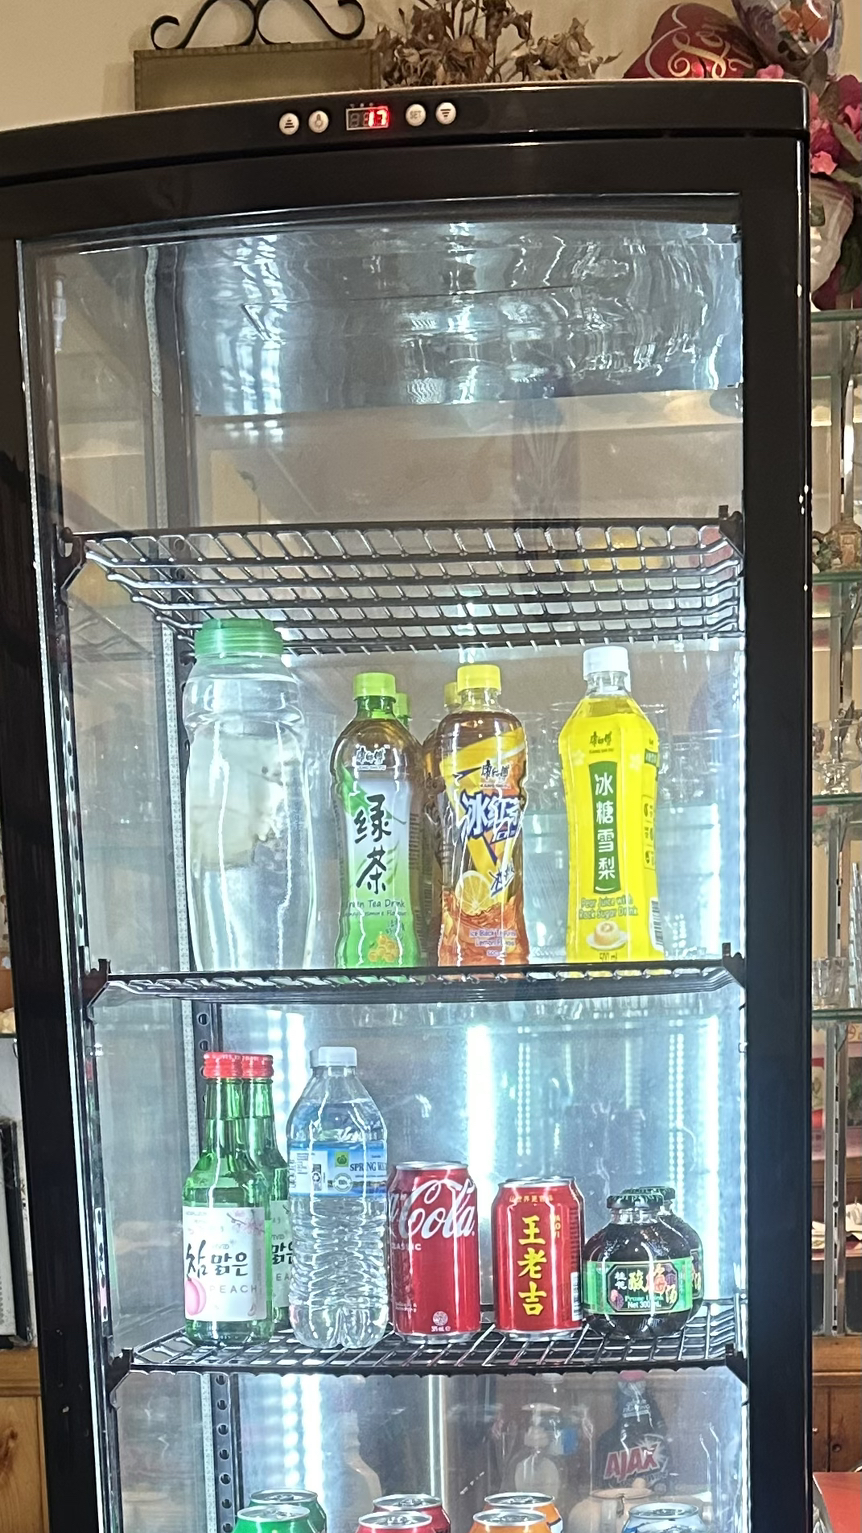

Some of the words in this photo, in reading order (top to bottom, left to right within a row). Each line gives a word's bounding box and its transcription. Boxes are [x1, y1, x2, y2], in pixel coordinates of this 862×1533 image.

[369, 110, 387, 127] 17
[409, 110, 422, 119] SET
[594, 772, 618, 881] 冰糖雪梨
[353, 793, 392, 895] 绿茶
[368, 899, 383, 908] Tea
[384, 898, 405, 908] Drnk
[350, 1163, 377, 1172] SPRNG
[517, 1214, 548, 1317] 王老吉
[209, 1284, 258, 1294] PEACH
[604, 1442, 660, 1482] AJAX
